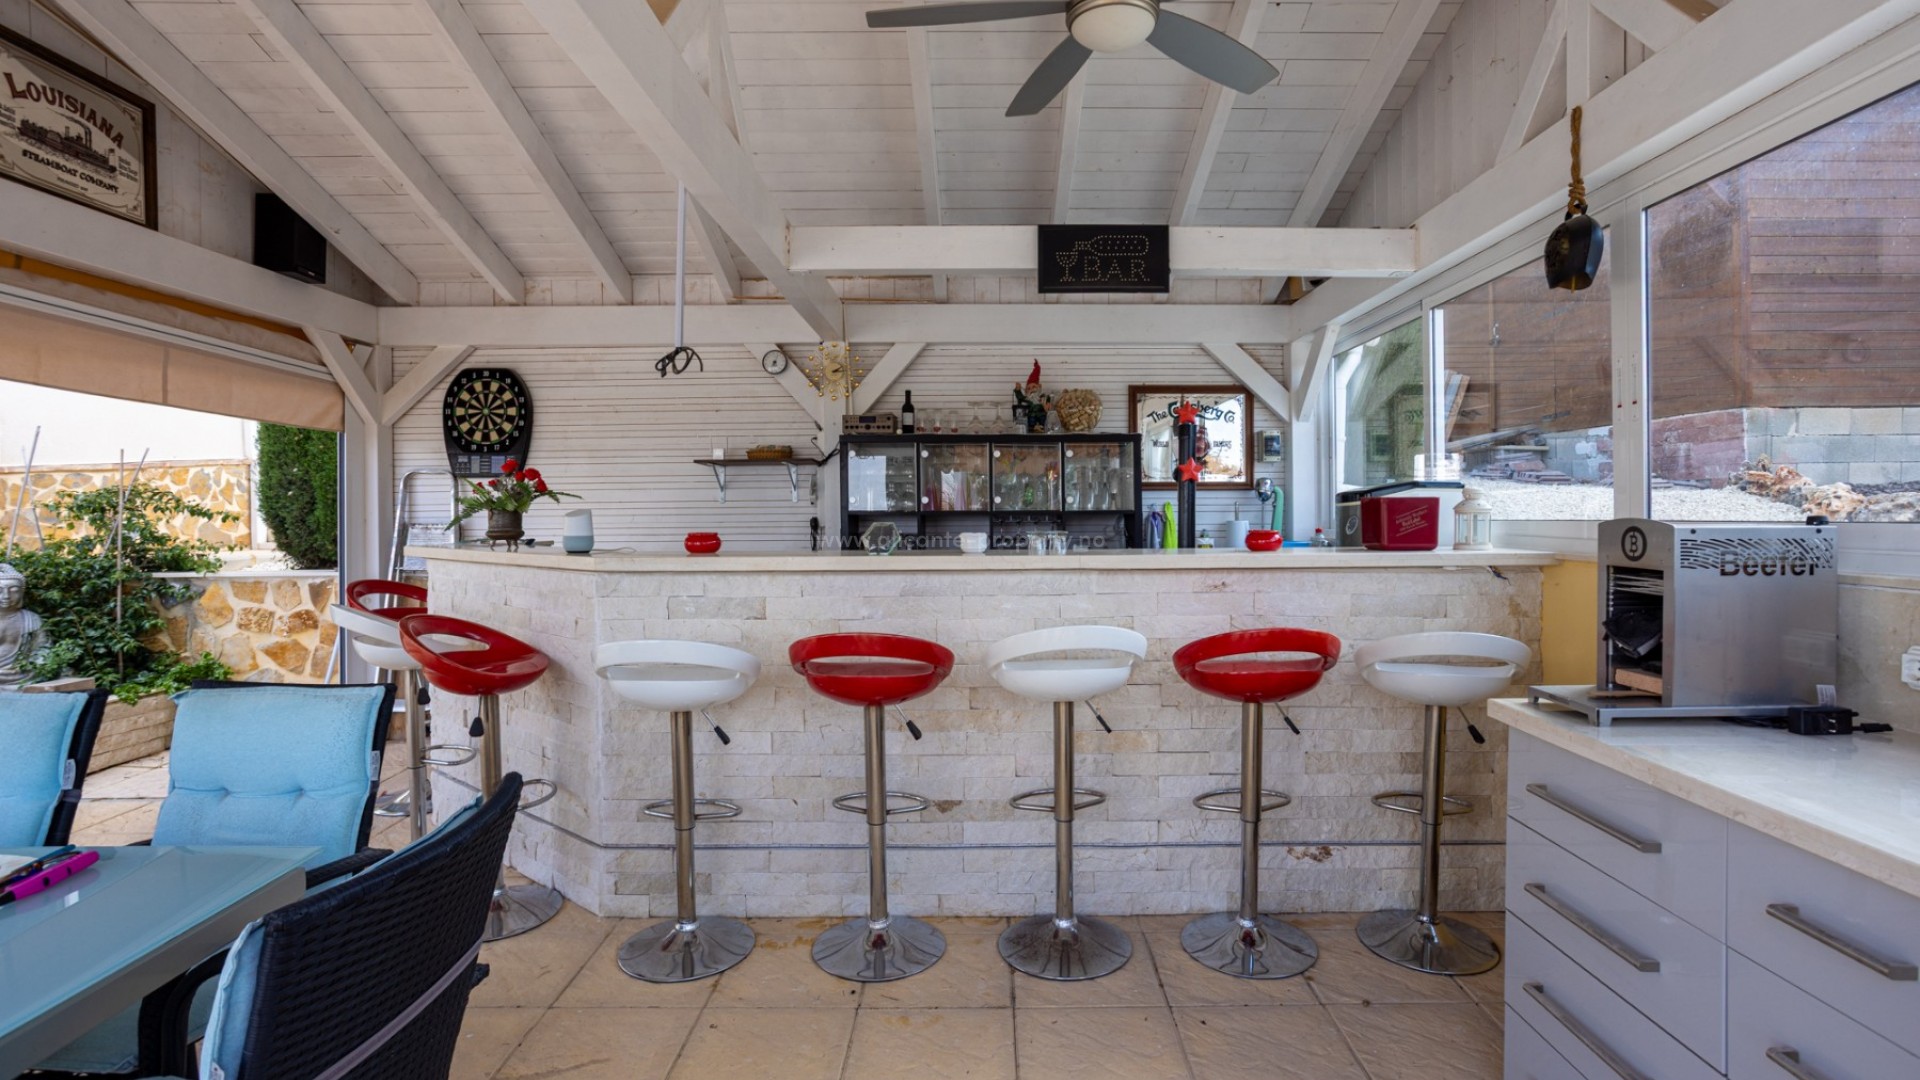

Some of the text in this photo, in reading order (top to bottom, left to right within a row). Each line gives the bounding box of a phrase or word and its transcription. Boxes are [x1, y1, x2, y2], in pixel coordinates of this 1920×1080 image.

[3, 71, 125, 149] LOUISIANA
[22, 149, 79, 177] STEAMBOAT
[79, 171, 120, 194] COMPANY
[1082, 256, 1150, 281] BAR
[1146, 410, 1168, 423] The
[1168, 400, 1224, 421] Cberg
[1719, 550, 1815, 576] Beefer
